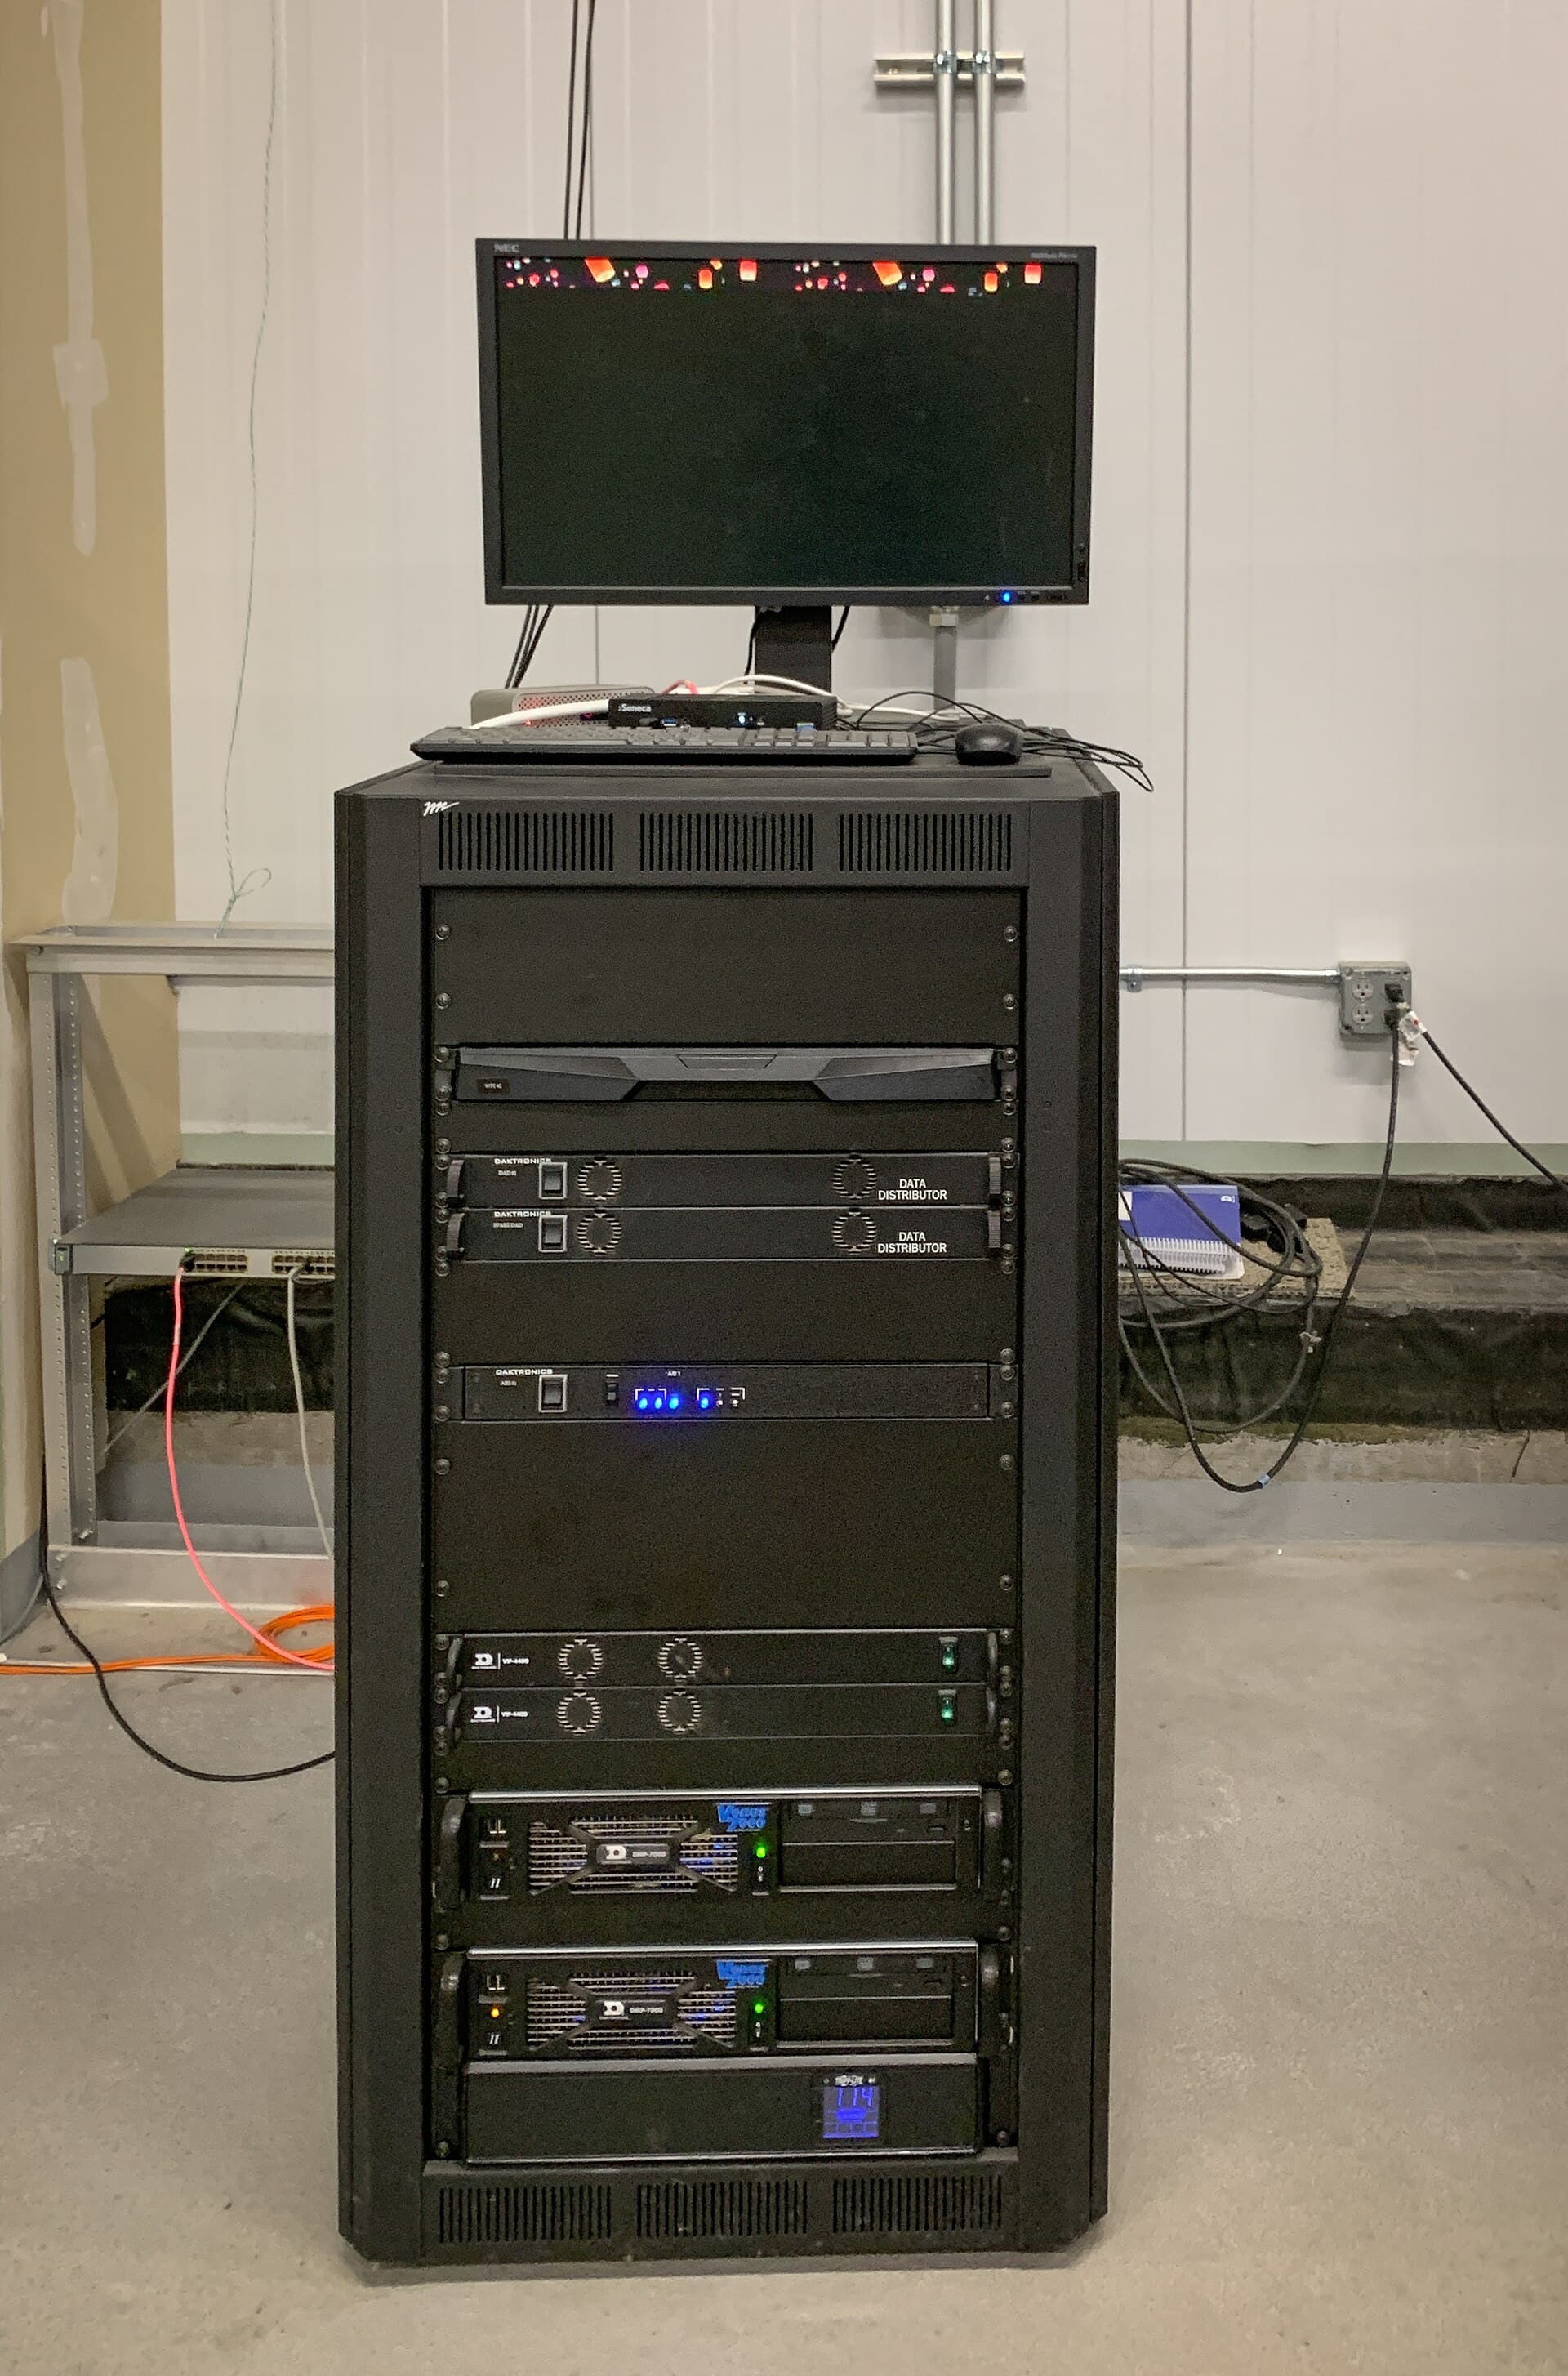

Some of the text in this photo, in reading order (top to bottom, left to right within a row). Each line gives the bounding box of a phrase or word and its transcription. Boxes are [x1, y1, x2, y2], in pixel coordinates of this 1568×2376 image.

[494, 243, 519, 252] NEC
[899, 1178, 926, 1189] DATA
[878, 1189, 947, 1201] DISTRIBUTOR
[898, 1231, 926, 1242] DATA
[877, 1242, 947, 1254] DISTRIBUTOR
[837, 2087, 874, 2106] 114
